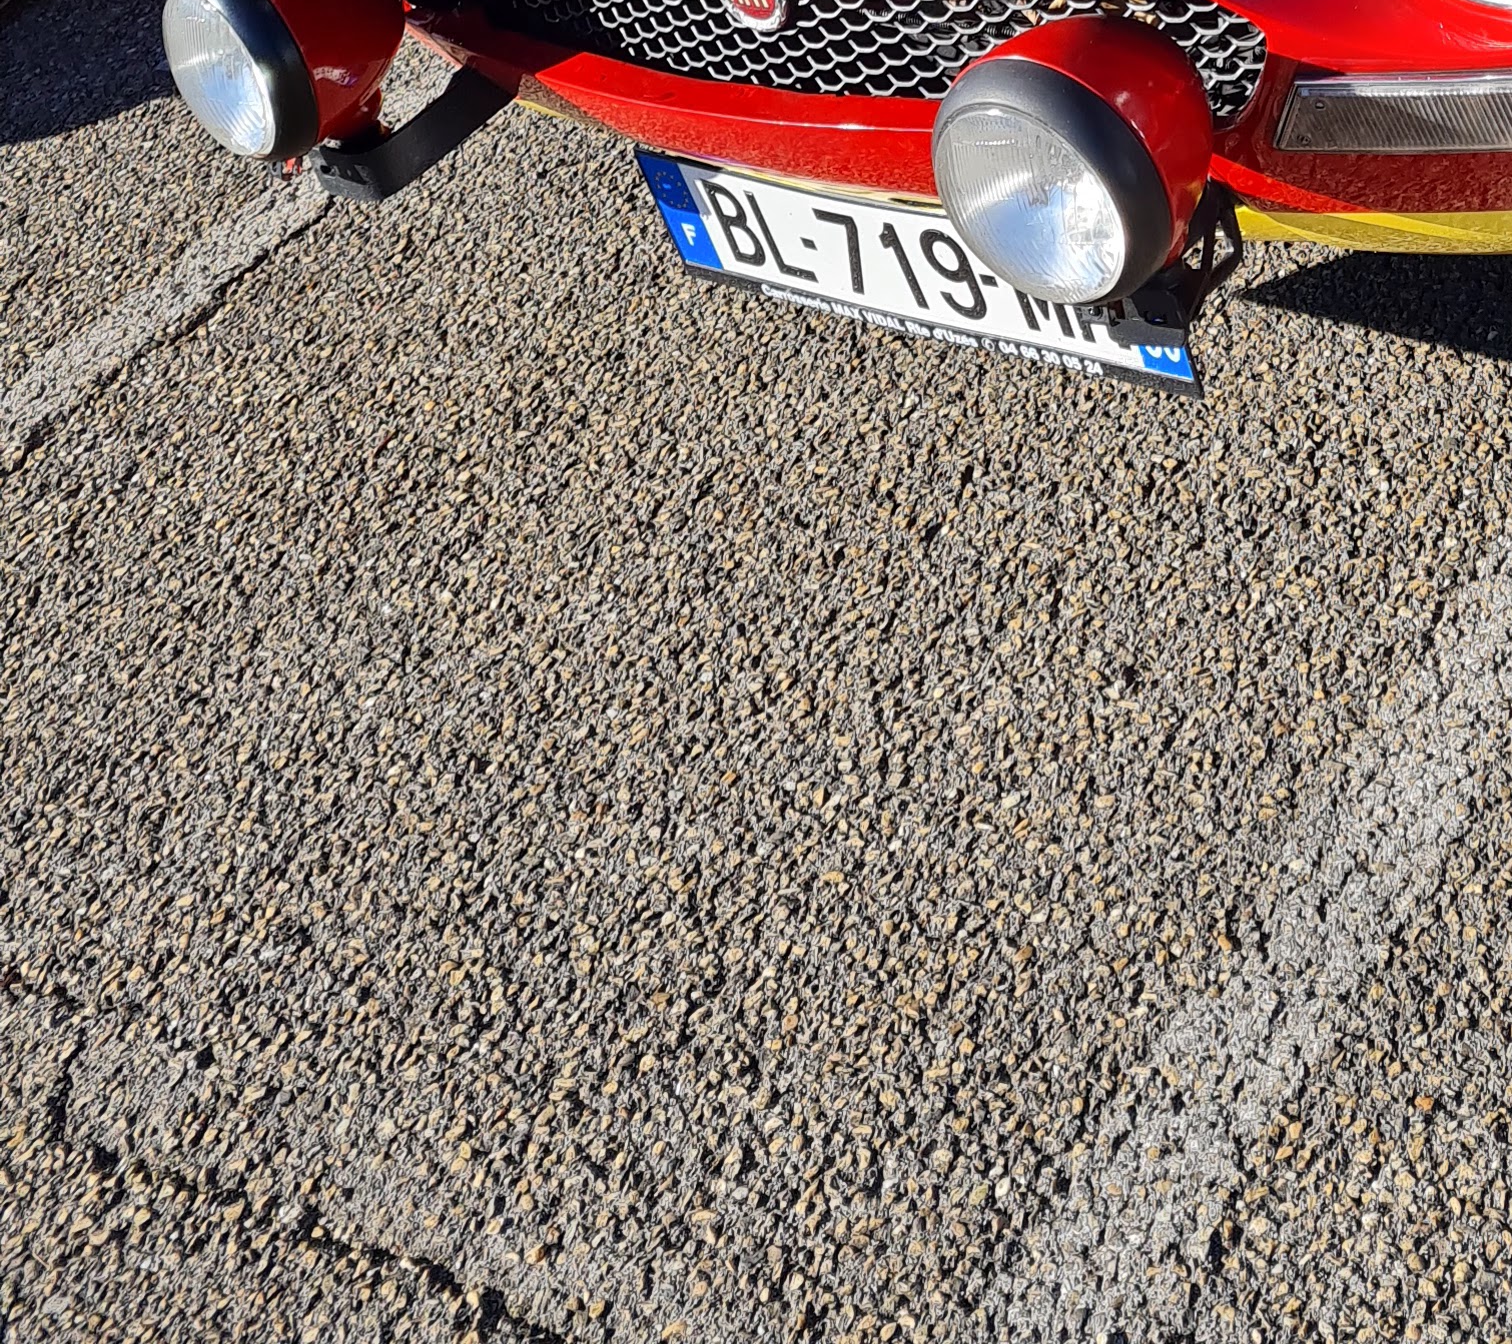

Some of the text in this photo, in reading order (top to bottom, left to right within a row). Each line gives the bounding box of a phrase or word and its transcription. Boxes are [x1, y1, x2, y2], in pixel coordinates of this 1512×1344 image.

[682, 222, 696, 246] F
[761, 283, 831, 313] Carrosserie
[831, 302, 863, 321] MAX
[862, 310, 905, 331] VIDAL
[906, 321, 930, 338] Rte
[998, 341, 1018, 356] 04
[1020, 345, 1040, 361] 66
[1041, 349, 1061, 365] 30
[1062, 355, 1082, 371] 05
[1084, 360, 1104, 376] 24
